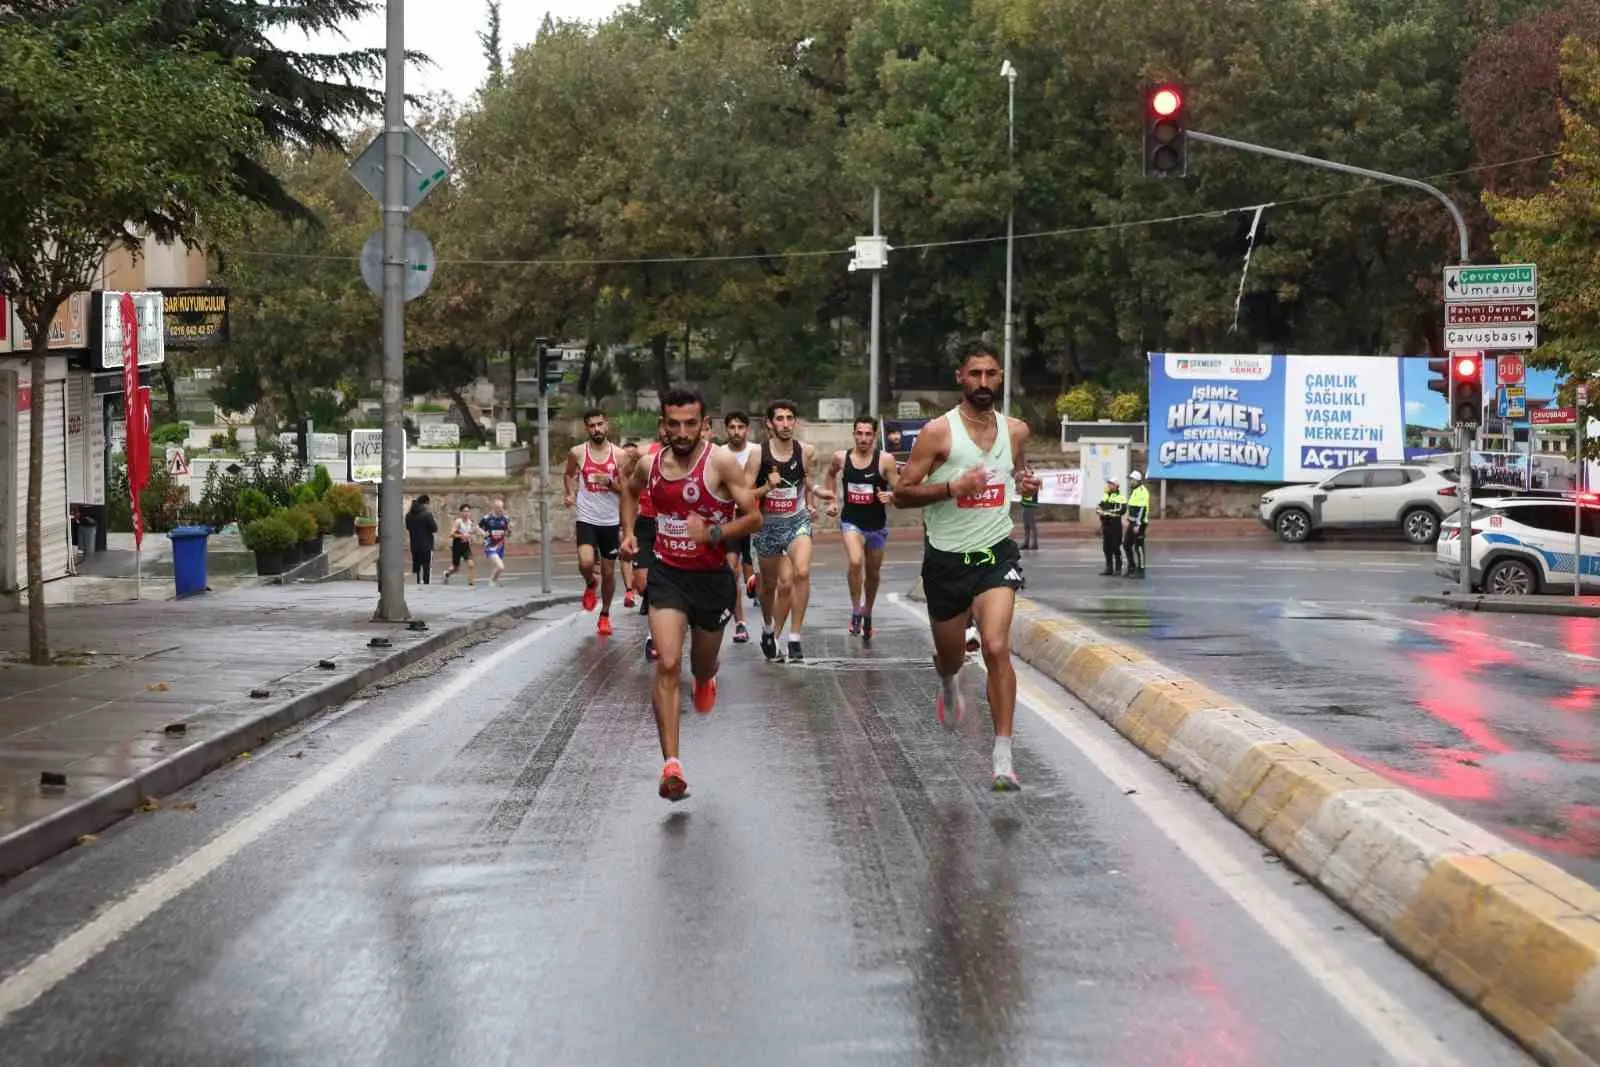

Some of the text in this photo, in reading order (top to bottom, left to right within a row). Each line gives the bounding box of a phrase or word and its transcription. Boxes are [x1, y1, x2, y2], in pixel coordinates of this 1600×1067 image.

[1460, 269, 1530, 282] Çevreyolu
[1500, 363, 1522, 376] DUR
[1305, 374, 1357, 391] ÇAMLIK
[1304, 388, 1365, 406] SAĞLIKLI
[1167, 399, 1266, 434] HİZMET,
[1304, 409, 1352, 426] YAŞAM
[353, 441, 381, 460] ÇİÇE
[1160, 440, 1271, 467] ÇEKMEKÖY
[1303, 448, 1368, 469] AÇTIK
